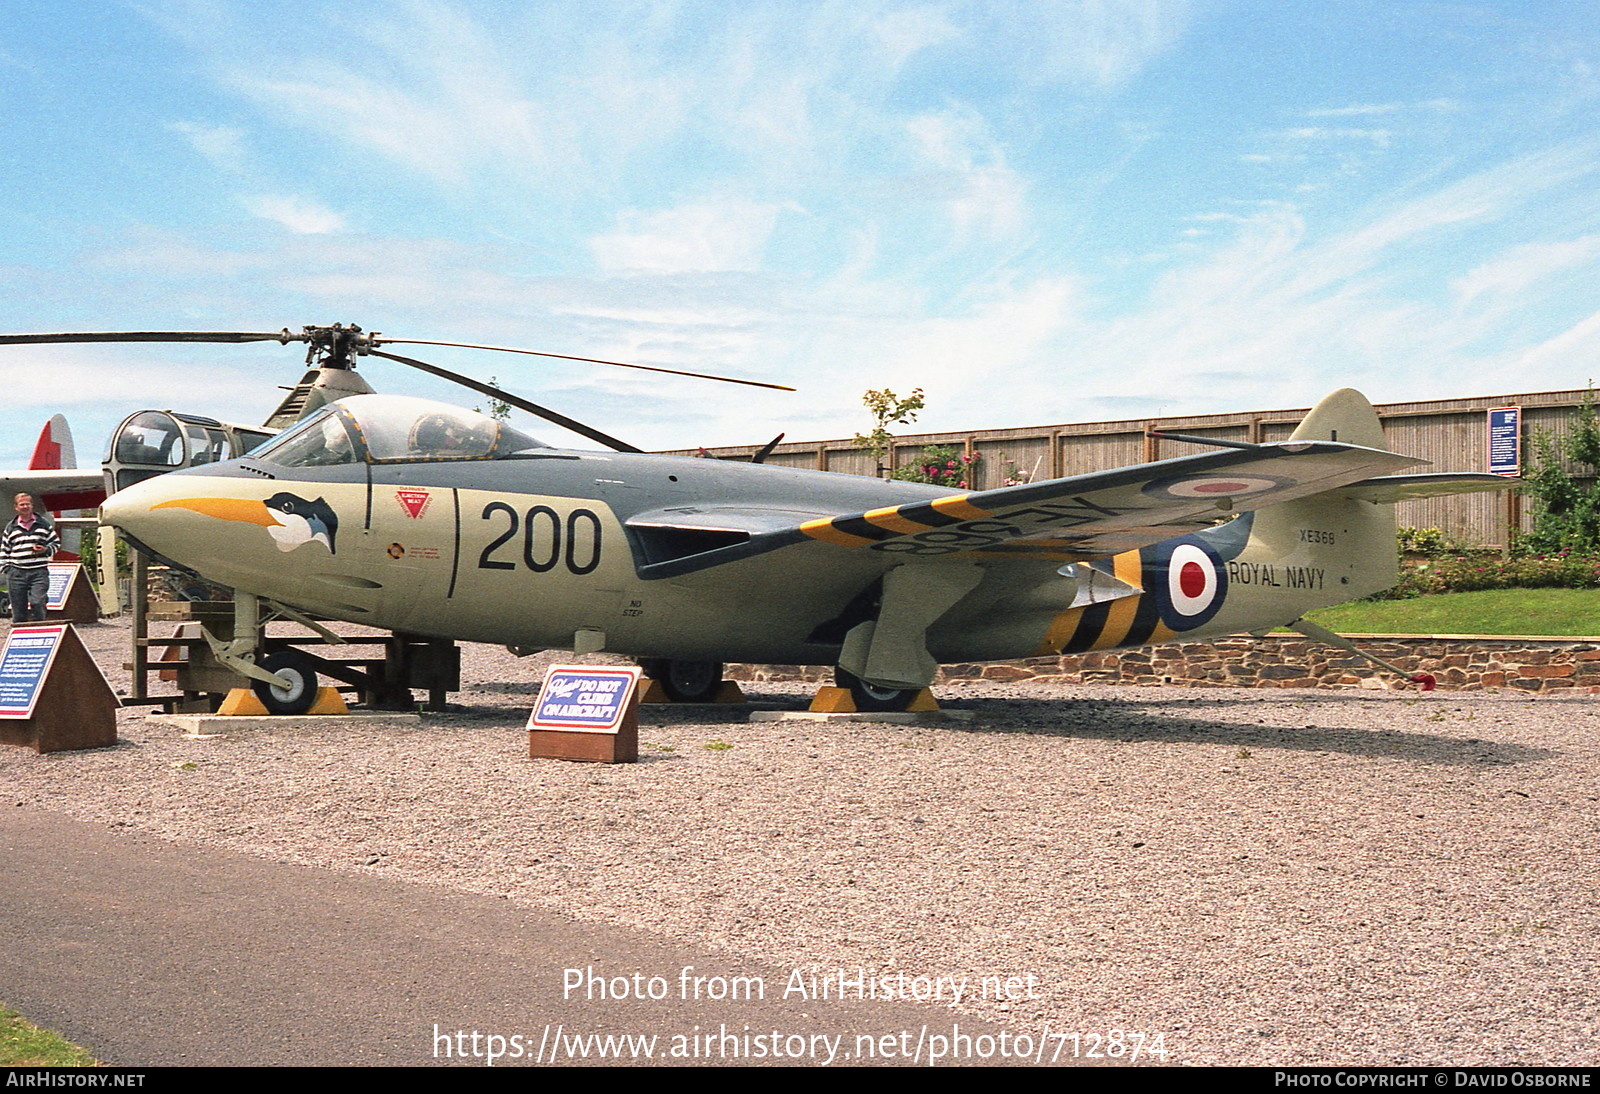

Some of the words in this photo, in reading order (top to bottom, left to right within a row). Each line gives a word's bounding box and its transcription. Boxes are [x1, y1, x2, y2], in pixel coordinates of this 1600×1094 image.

[478, 501, 602, 575] 200
[1300, 529, 1336, 545] XE368
[1229, 561, 1281, 587] ROYAL
[1286, 566, 1325, 590] NAVY
[630, 600, 642, 608] NO
[622, 609, 644, 617] STEP
[579, 680, 598, 692] DO
[597, 681, 622, 693] NOT
[576, 693, 615, 705] CLIMB
[542, 703, 561, 716] ON
[559, 704, 617, 718] AIRCRAFT
